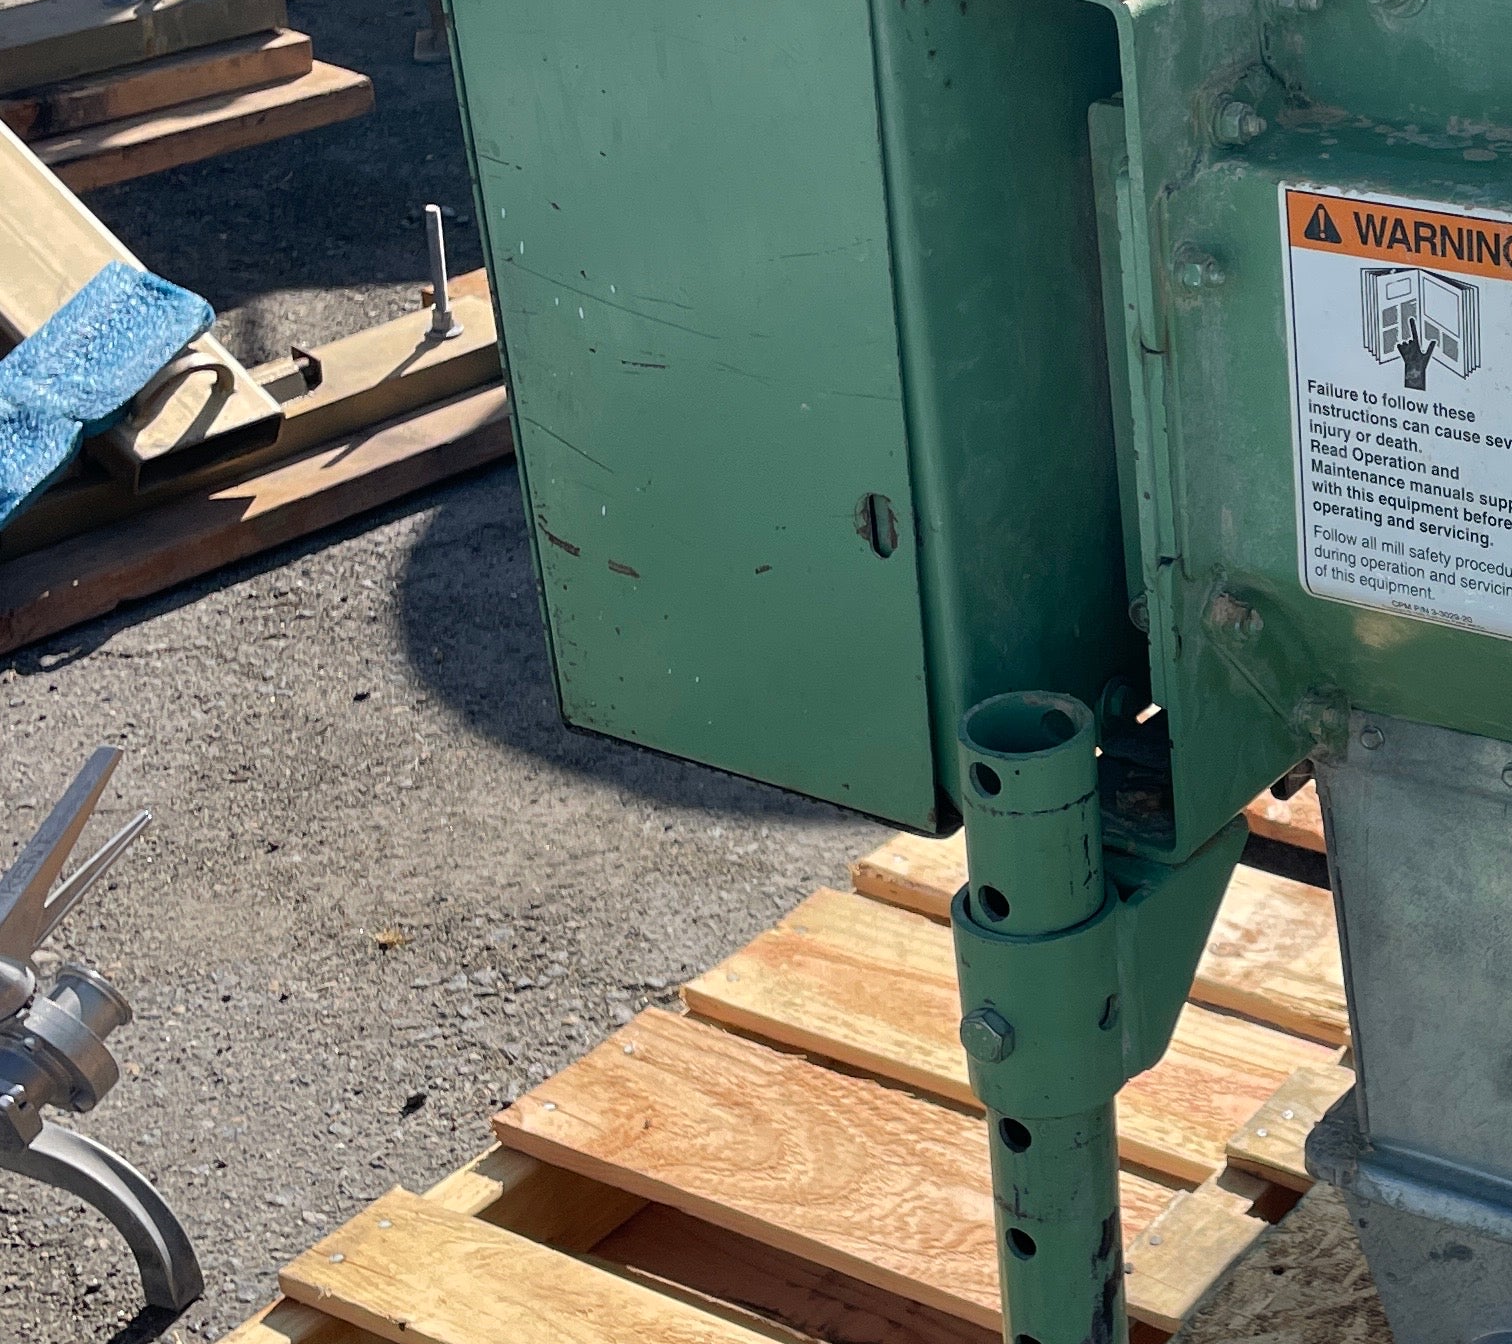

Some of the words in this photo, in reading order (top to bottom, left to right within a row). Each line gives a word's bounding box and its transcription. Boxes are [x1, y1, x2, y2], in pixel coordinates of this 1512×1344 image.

[1307, 379, 1359, 402] Failure
[1362, 390, 1378, 406] to
[1382, 393, 1429, 414] follow
[1433, 402, 1476, 423] these
[1308, 399, 1398, 429] instructions
[1402, 419, 1430, 435] can
[1434, 426, 1481, 444] cause
[1309, 419, 1351, 443] injury
[1355, 430, 1372, 444] or
[1376, 433, 1423, 454] death.
[1310, 439, 1348, 459] Read
[1352, 447, 1426, 474] Operation
[1431, 463, 1460, 480] and
[1311, 459, 1405, 489] Maintenance
[1409, 479, 1475, 503] manuals
[1311, 480, 1343, 497] with
[1346, 485, 1374, 503] this
[1378, 494, 1459, 520] equipment
[1463, 508, 1512, 530] before
[1312, 499, 1383, 527] operating
[1387, 514, 1415, 530] and
[1419, 520, 1495, 549] servicing.
[1313, 524, 1357, 546] Follow
[1361, 535, 1377, 551] all
[1381, 539, 1405, 556] mill
[1409, 545, 1452, 568] safety
[1314, 545, 1356, 568] during
[1360, 556, 1425, 579] operation
[1429, 569, 1456, 586] and
[1315, 563, 1328, 577] of
[1331, 567, 1355, 584] this
[1359, 573, 1436, 600] equipment.
[1391, 600, 1412, 610] CPM
